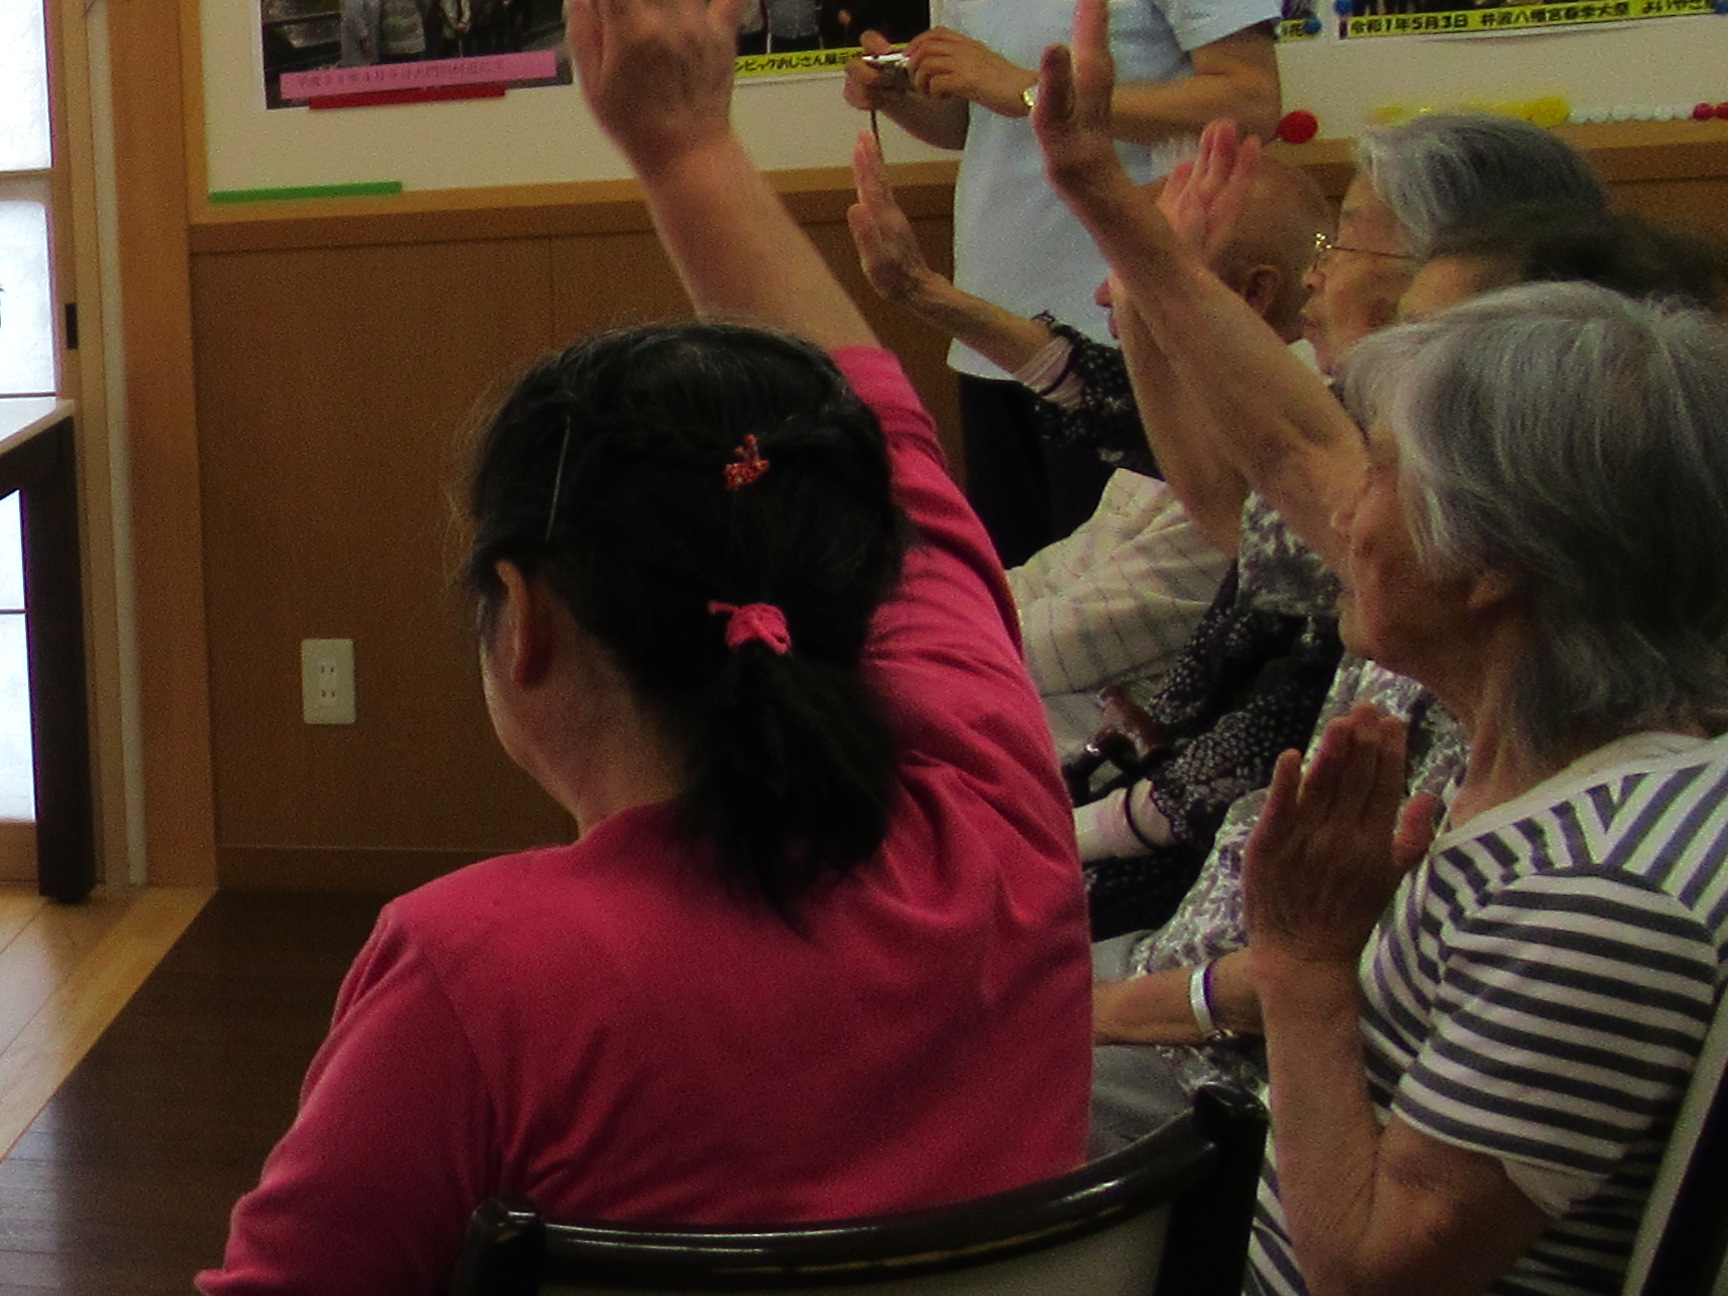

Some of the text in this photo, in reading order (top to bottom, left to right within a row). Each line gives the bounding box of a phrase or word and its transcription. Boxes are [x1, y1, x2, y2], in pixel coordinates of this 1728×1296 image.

[1351, 13, 1469, 35] 令和1年5月3日
